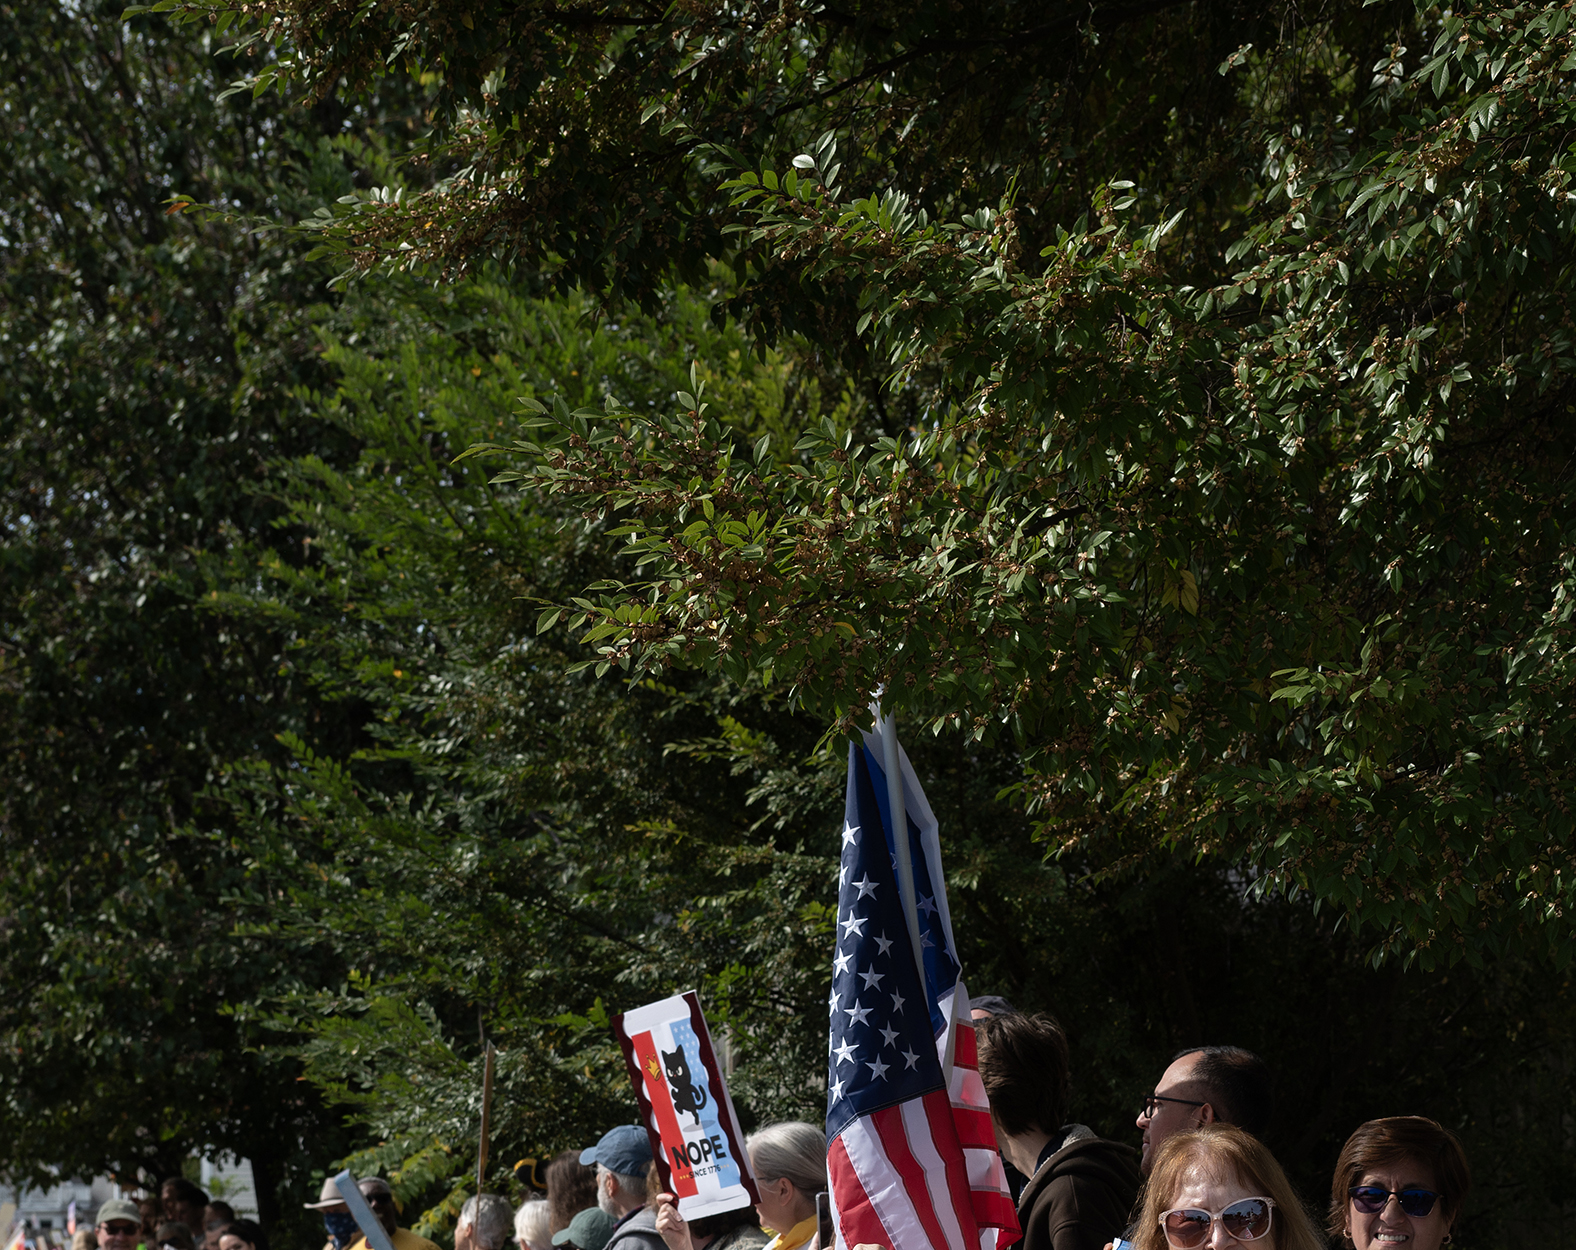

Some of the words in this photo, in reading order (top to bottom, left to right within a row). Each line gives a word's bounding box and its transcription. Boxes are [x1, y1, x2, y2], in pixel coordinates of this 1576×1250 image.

[671, 1135, 727, 1170] NOPE
[689, 1167, 707, 1179] SINCE
[708, 1164, 721, 1174] 1776
